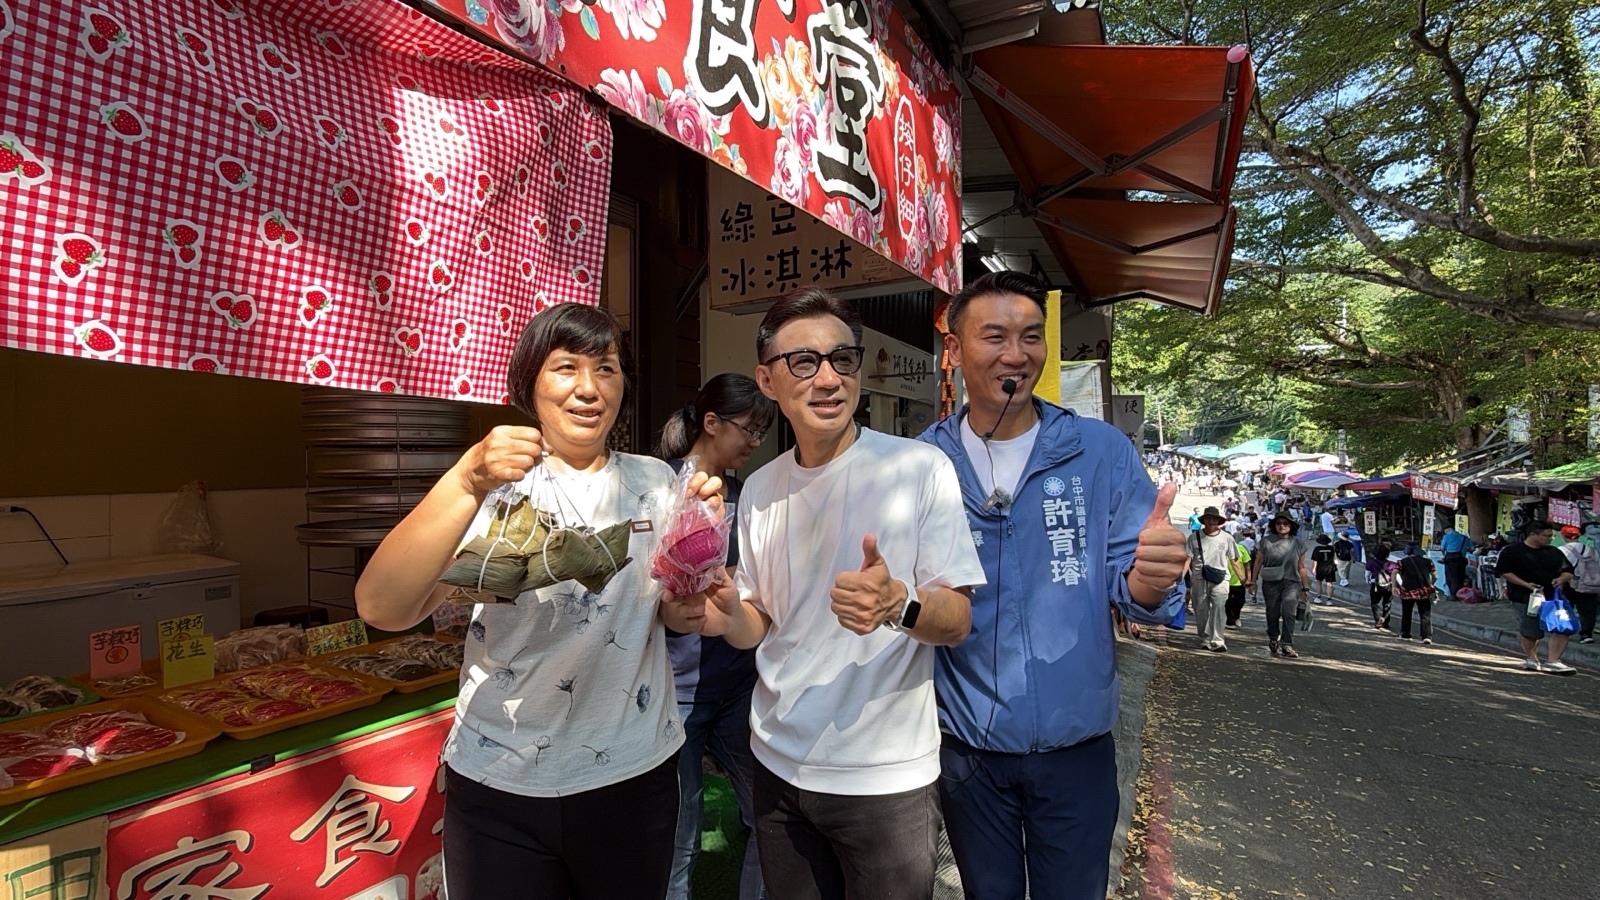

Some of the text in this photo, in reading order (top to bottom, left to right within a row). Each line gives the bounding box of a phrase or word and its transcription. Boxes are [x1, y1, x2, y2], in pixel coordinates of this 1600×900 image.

[719, 194, 819, 243] 綠豆
[720, 239, 852, 296] 冰淇淋
[1070, 475, 1088, 558] 台中市議員參選人
[160, 615, 203, 636] 芋粿巧
[165, 639, 207, 662] 花生
[116, 765, 446, 900] 家食
